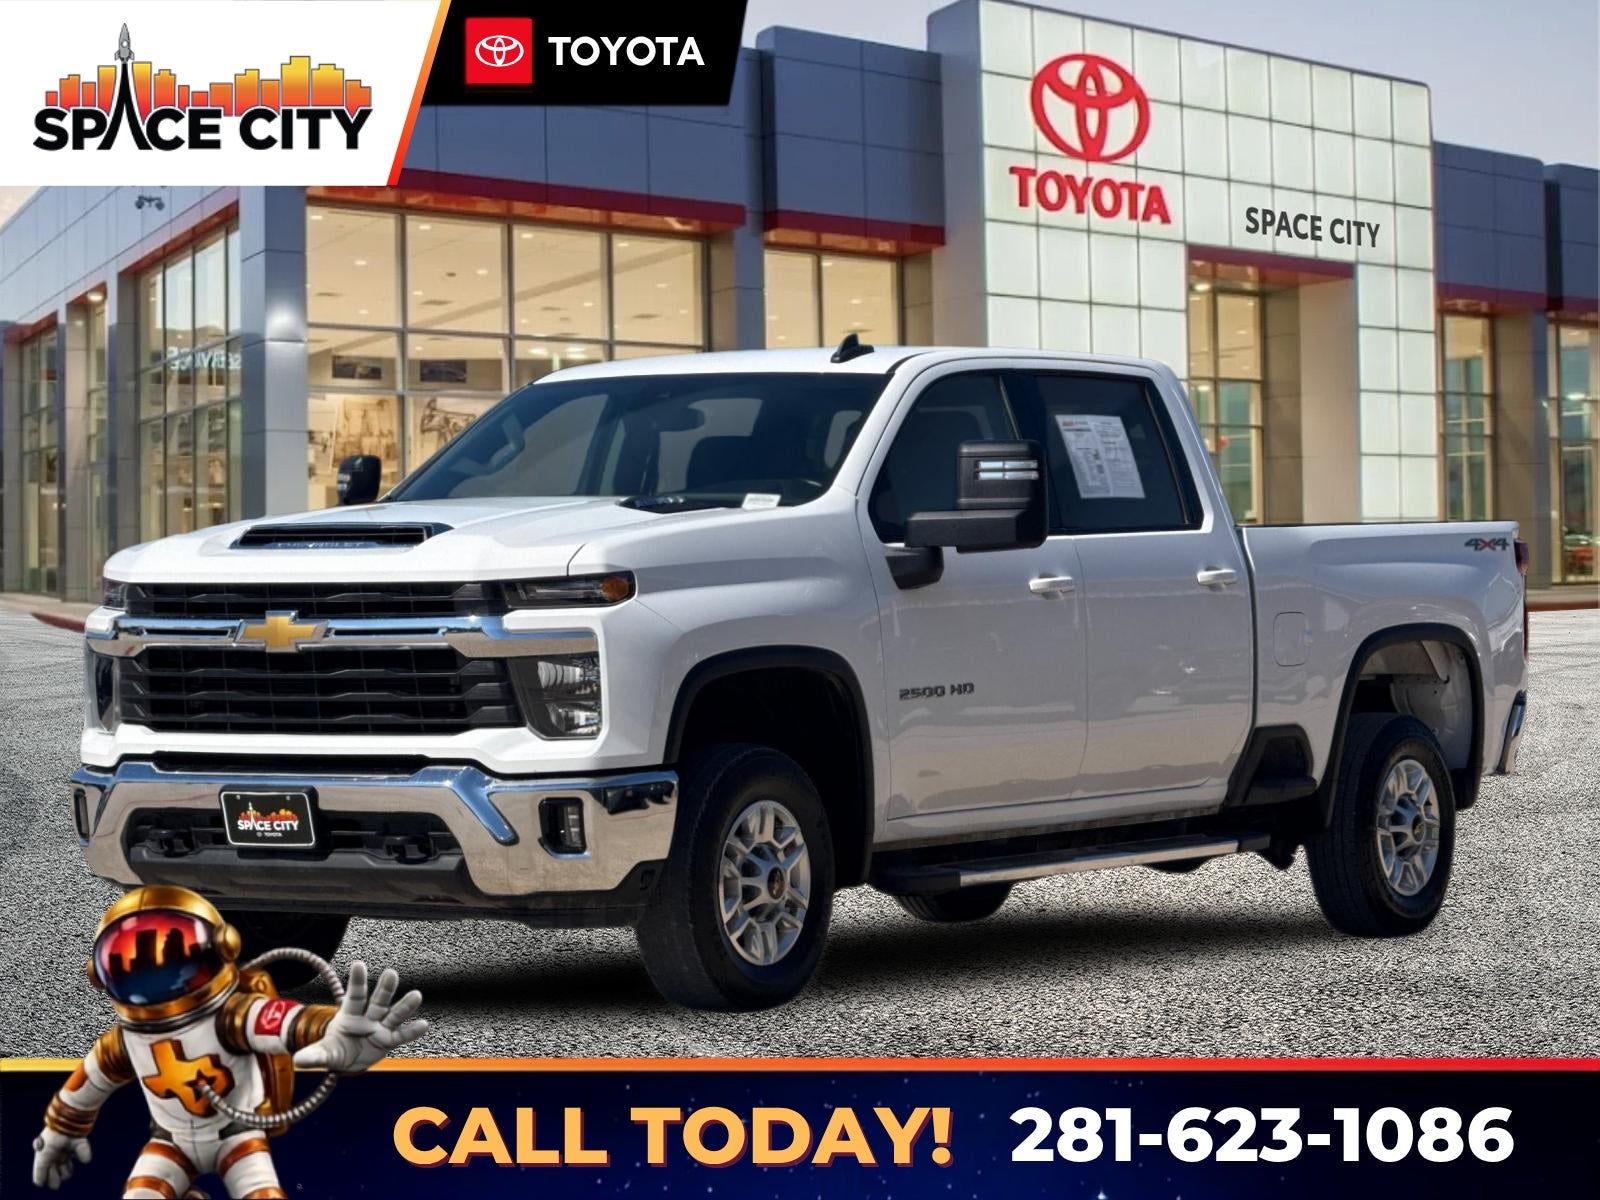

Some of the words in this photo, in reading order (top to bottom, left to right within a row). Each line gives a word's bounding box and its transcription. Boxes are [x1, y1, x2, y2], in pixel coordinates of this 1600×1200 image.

[1009, 166, 1171, 224] TOYOTA
[1245, 206, 1323, 242] SPACE
[1329, 217, 1380, 248] CITY
[899, 685, 946, 701] 2500
[950, 682, 975, 696] HD
[238, 819, 272, 831] SPACE
[273, 820, 299, 831] CITY
